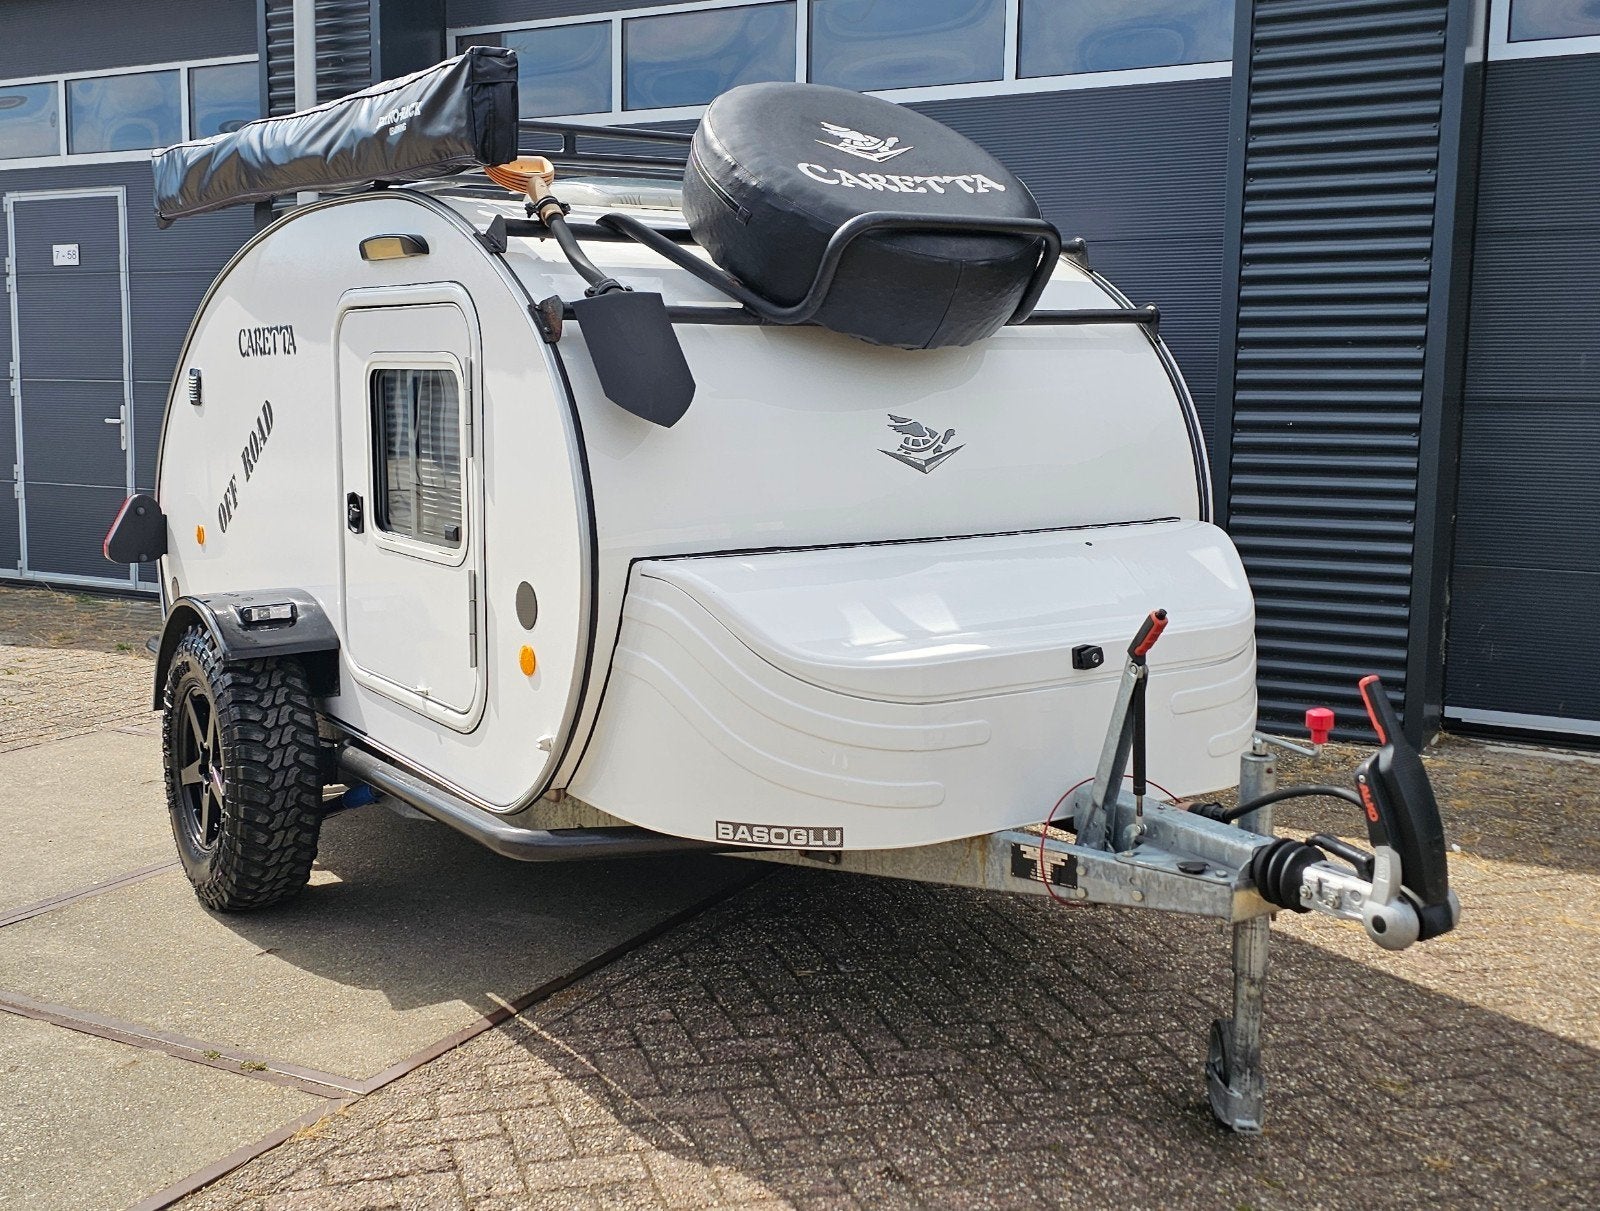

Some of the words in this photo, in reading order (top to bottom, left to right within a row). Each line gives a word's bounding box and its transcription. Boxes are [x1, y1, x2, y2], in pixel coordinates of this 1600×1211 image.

[797, 162, 1006, 194] CARETTA
[238, 324, 297, 358] CARETTA
[218, 472, 238, 534] OFF
[241, 399, 273, 483] ROAD
